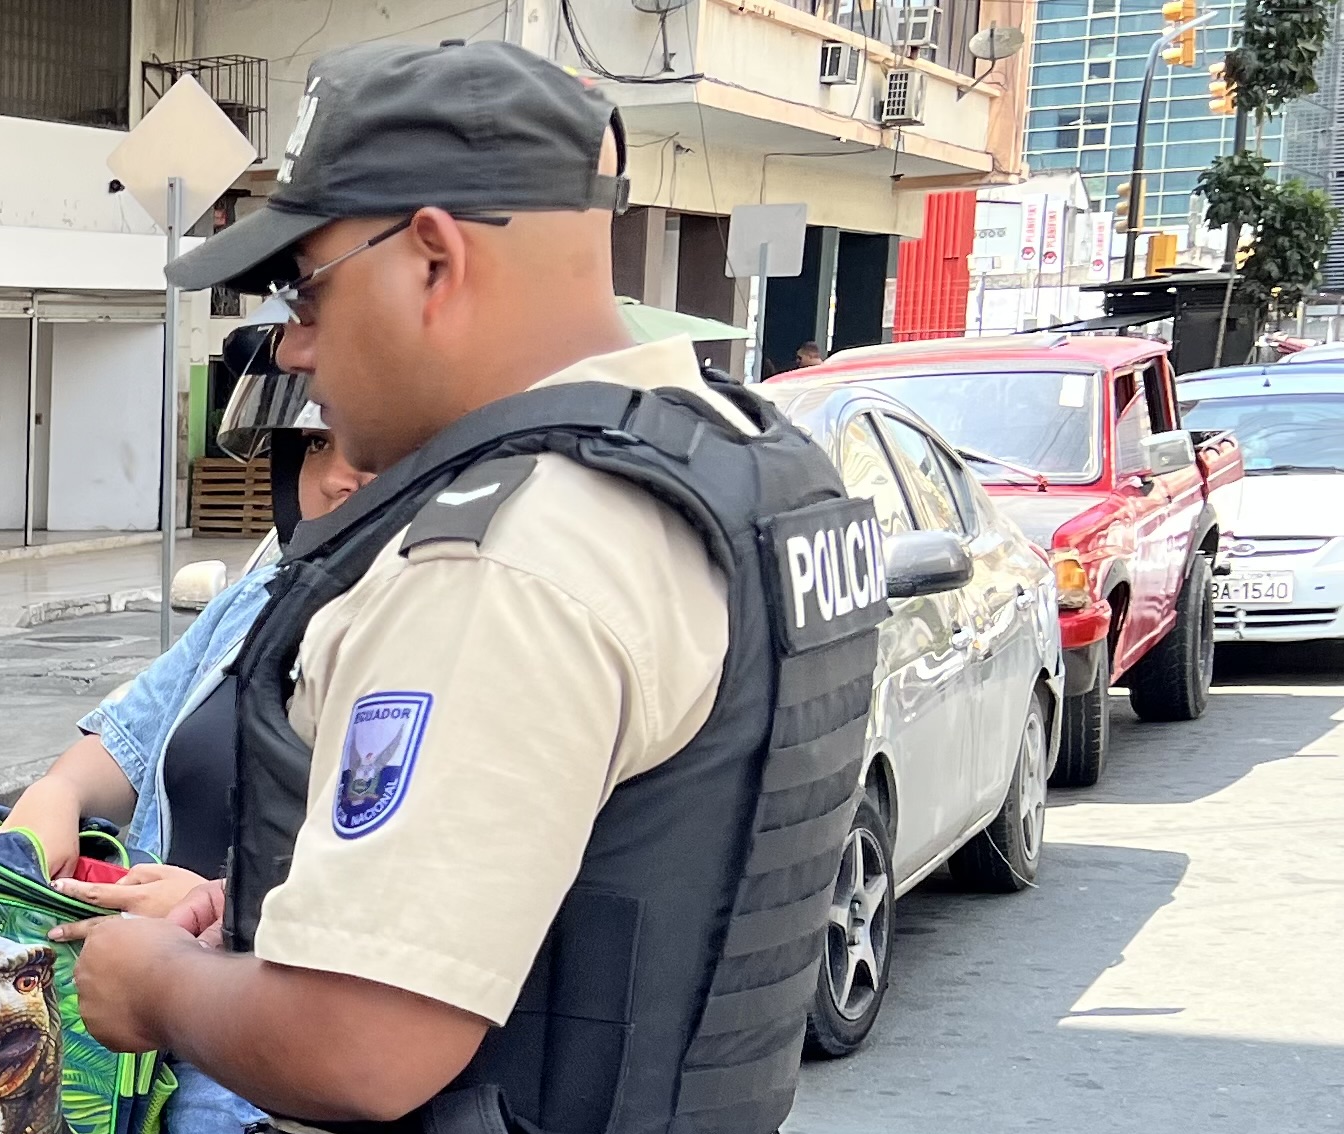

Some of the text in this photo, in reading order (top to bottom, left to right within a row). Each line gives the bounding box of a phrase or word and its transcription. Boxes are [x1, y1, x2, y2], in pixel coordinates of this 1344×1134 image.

[787, 518, 887, 628] POLICIA
[1212, 582, 1288, 599] BA-1540
[353, 707, 412, 725] ECUADOR
